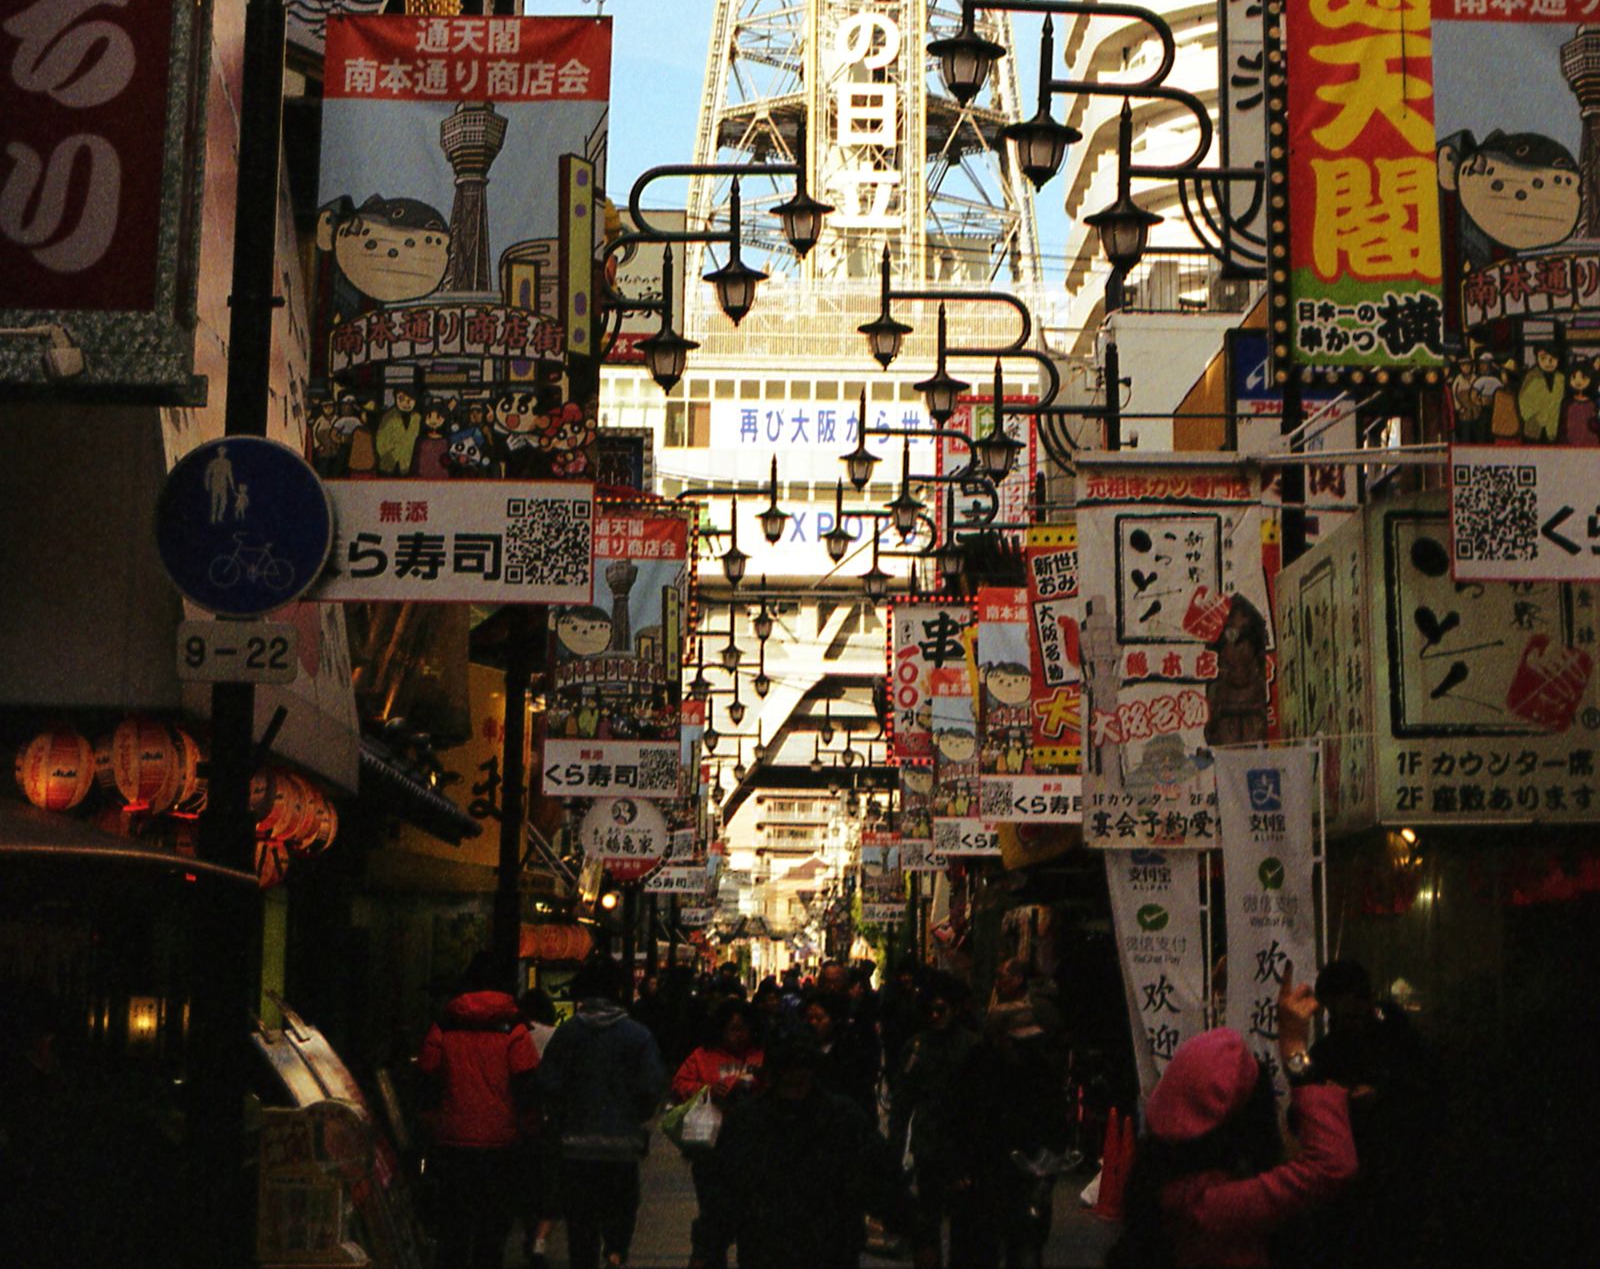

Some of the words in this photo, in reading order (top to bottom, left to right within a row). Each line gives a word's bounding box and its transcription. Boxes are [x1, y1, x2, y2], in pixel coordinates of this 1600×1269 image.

[415, 18, 521, 54] 通天閣
[344, 58, 592, 96] 南本通り商店会
[1465, 260, 1598, 309] 南本通り
[1297, 301, 1376, 323] 日本一の
[333, 310, 565, 356] 南本通り商店街
[1298, 325, 1376, 353] 串かつ
[740, 407, 936, 444] 再び大阪から世
[379, 500, 429, 523] 無添
[594, 518, 644, 537] 通天閣
[1541, 504, 1600, 556] く
[332, 532, 502, 582] ら寿司
[1040, 605, 1064, 681] 大阪名物
[1090, 690, 1210, 748] 大阪名物
[544, 763, 639, 788] くら寿司
[1397, 751, 1422, 776] 1F
[1431, 749, 1595, 777] カウンター席
[1396, 786, 1424, 811] 2F
[1432, 784, 1596, 813] 座敷あります
